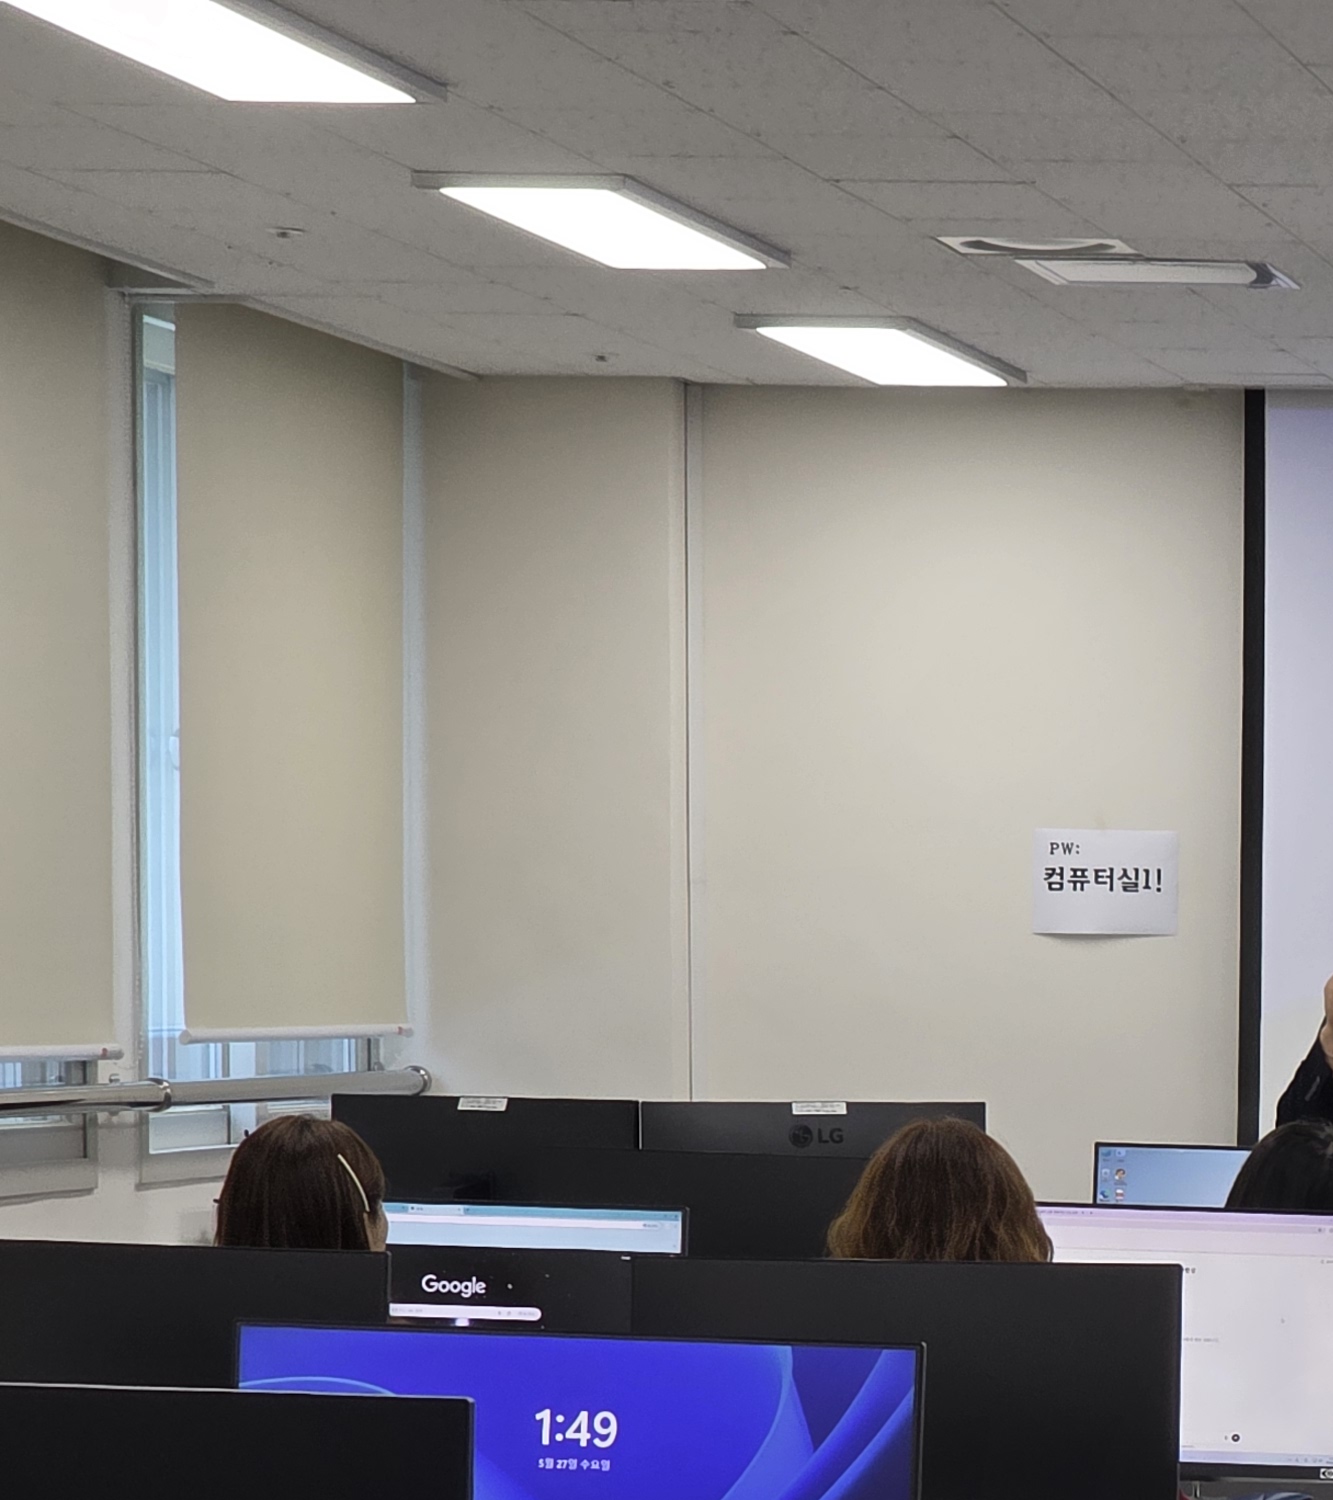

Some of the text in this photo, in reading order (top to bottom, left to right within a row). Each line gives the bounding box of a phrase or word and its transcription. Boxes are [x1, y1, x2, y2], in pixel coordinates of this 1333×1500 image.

[1049, 842, 1081, 856] PW:
[1043, 866, 1163, 893] 컴퓨터실1!
[817, 1127, 845, 1145] LG
[421, 1273, 487, 1298] Google
[535, 1408, 618, 1449] 1:49
